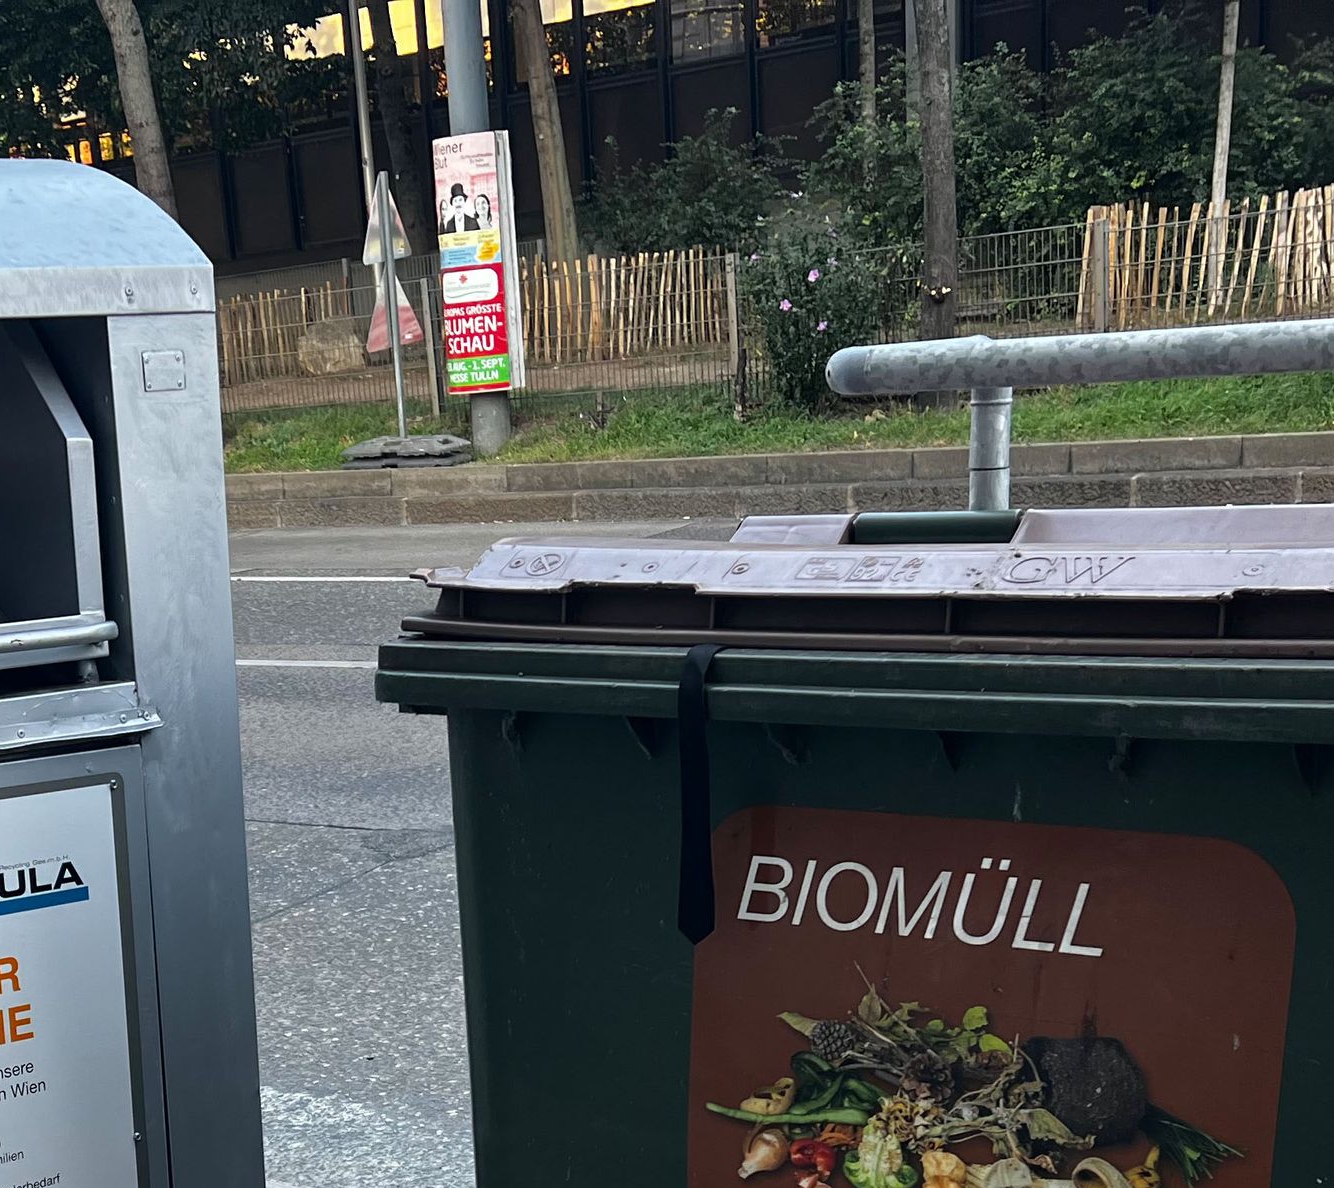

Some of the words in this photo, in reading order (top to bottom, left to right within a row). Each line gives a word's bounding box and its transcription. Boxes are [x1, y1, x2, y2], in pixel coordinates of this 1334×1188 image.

[465, 302, 502, 316] GRÖSSTE
[448, 333, 495, 354] SCHAU
[481, 357, 506, 370] SEPT.
[470, 370, 499, 382] TULLN
[736, 854, 1104, 958] BIOMÜLL
[11, 1079, 47, 1099] Wien
